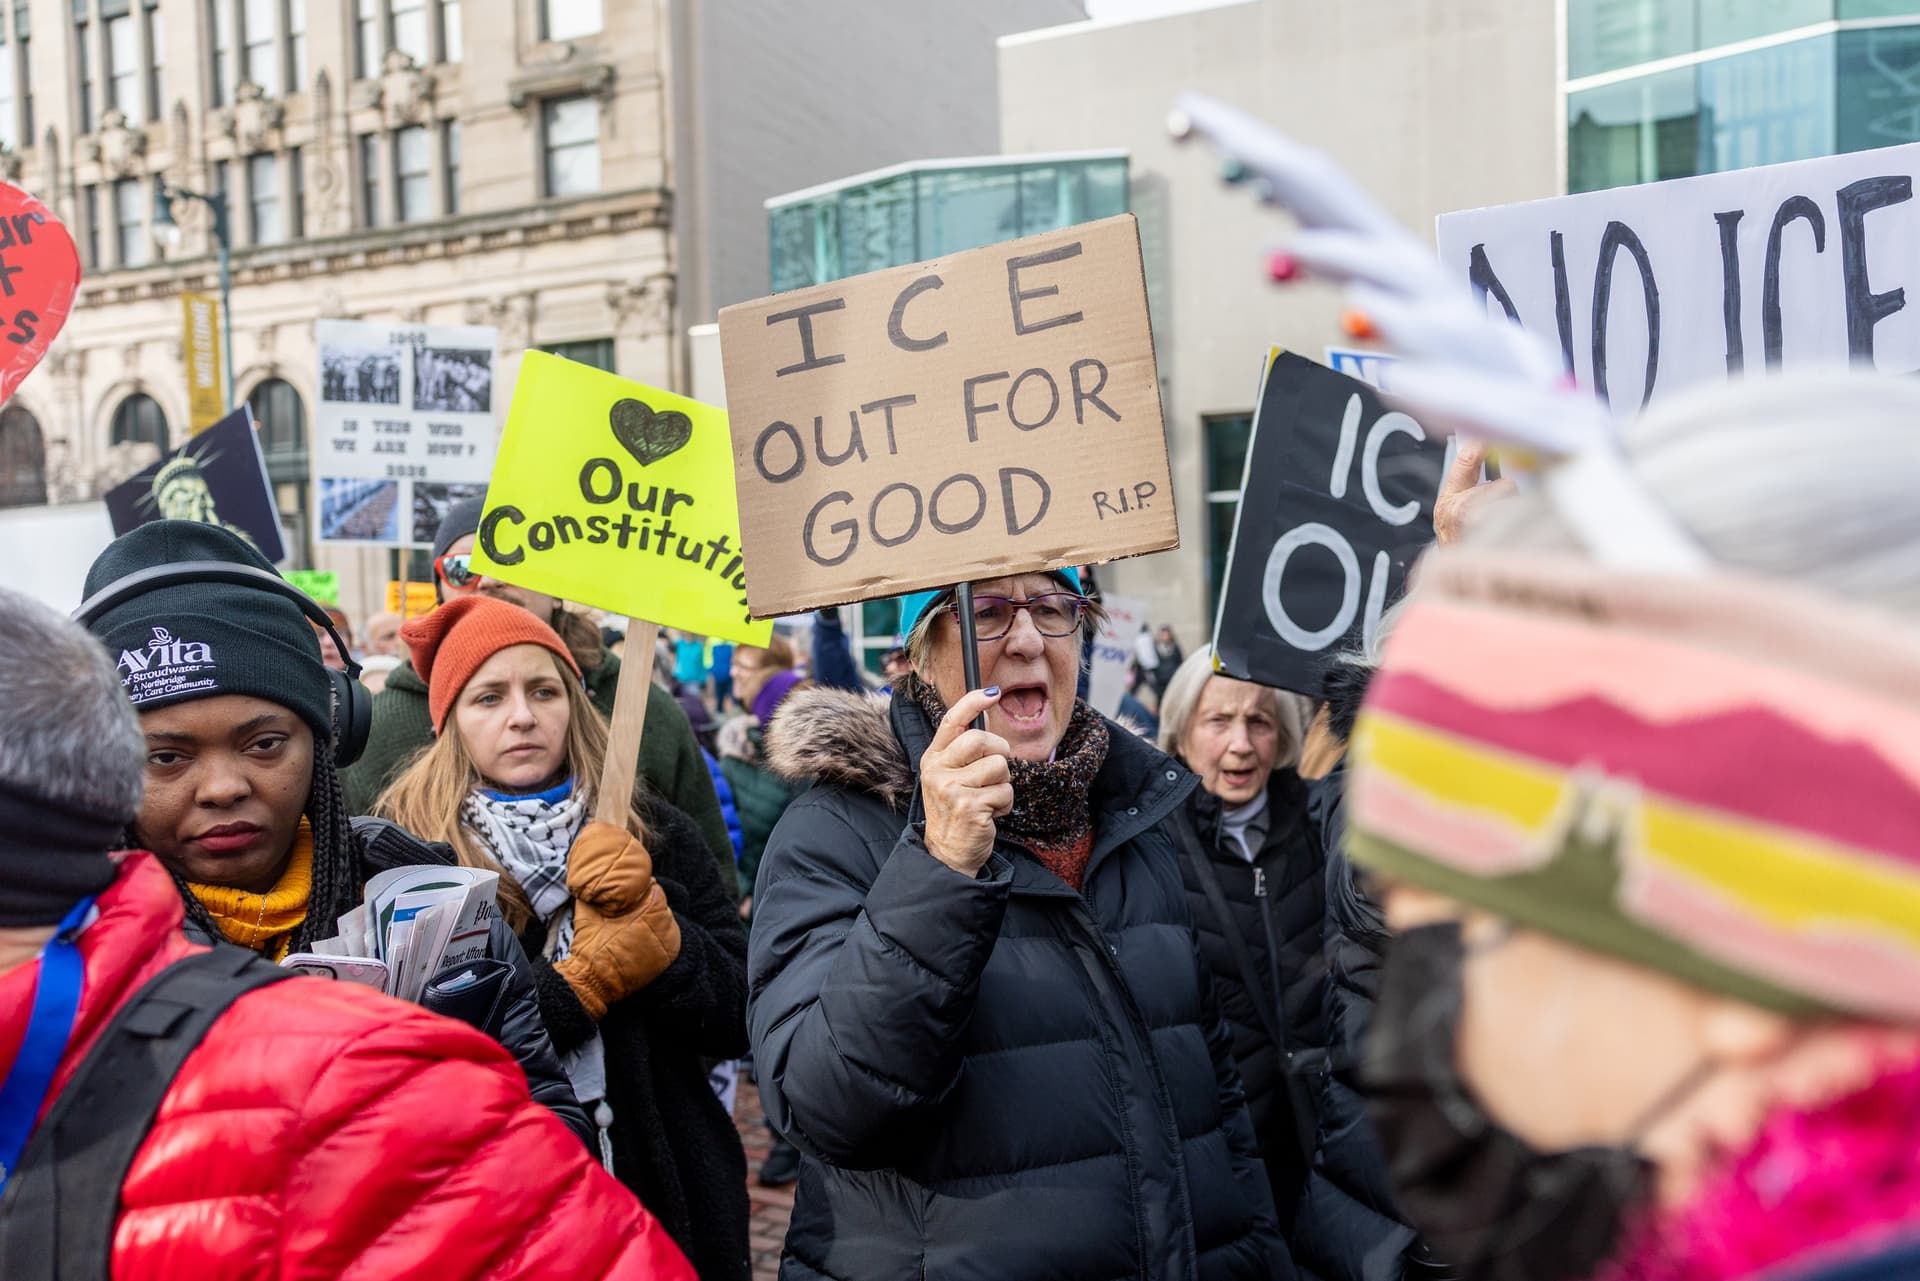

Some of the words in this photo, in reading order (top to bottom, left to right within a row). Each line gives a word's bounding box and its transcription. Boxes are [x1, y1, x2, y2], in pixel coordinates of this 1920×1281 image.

[766, 242, 1084, 377] ICE
[1714, 176, 1920, 378] ICE
[333, 439, 357, 452] WE
[374, 441, 406, 453] ARE
[343, 420, 358, 432] IS
[373, 420, 411, 433] THIS
[428, 423, 463, 436] WHO
[754, 394, 917, 483] OUT
[964, 358, 1122, 443] FOR
[1330, 393, 1456, 527] IC
[579, 457, 695, 516] Our
[803, 467, 1052, 567] GOOD
[1092, 481, 1157, 520] R.I.P.
[480, 505, 751, 624] Constitutio
[120, 674, 133, 686] of
[132, 665, 203, 683] Stroudwater
[133, 684, 139, 692] A
[141, 675, 187, 690] Northbridge
[144, 687, 164, 697] Care
[165, 678, 215, 692] Community
